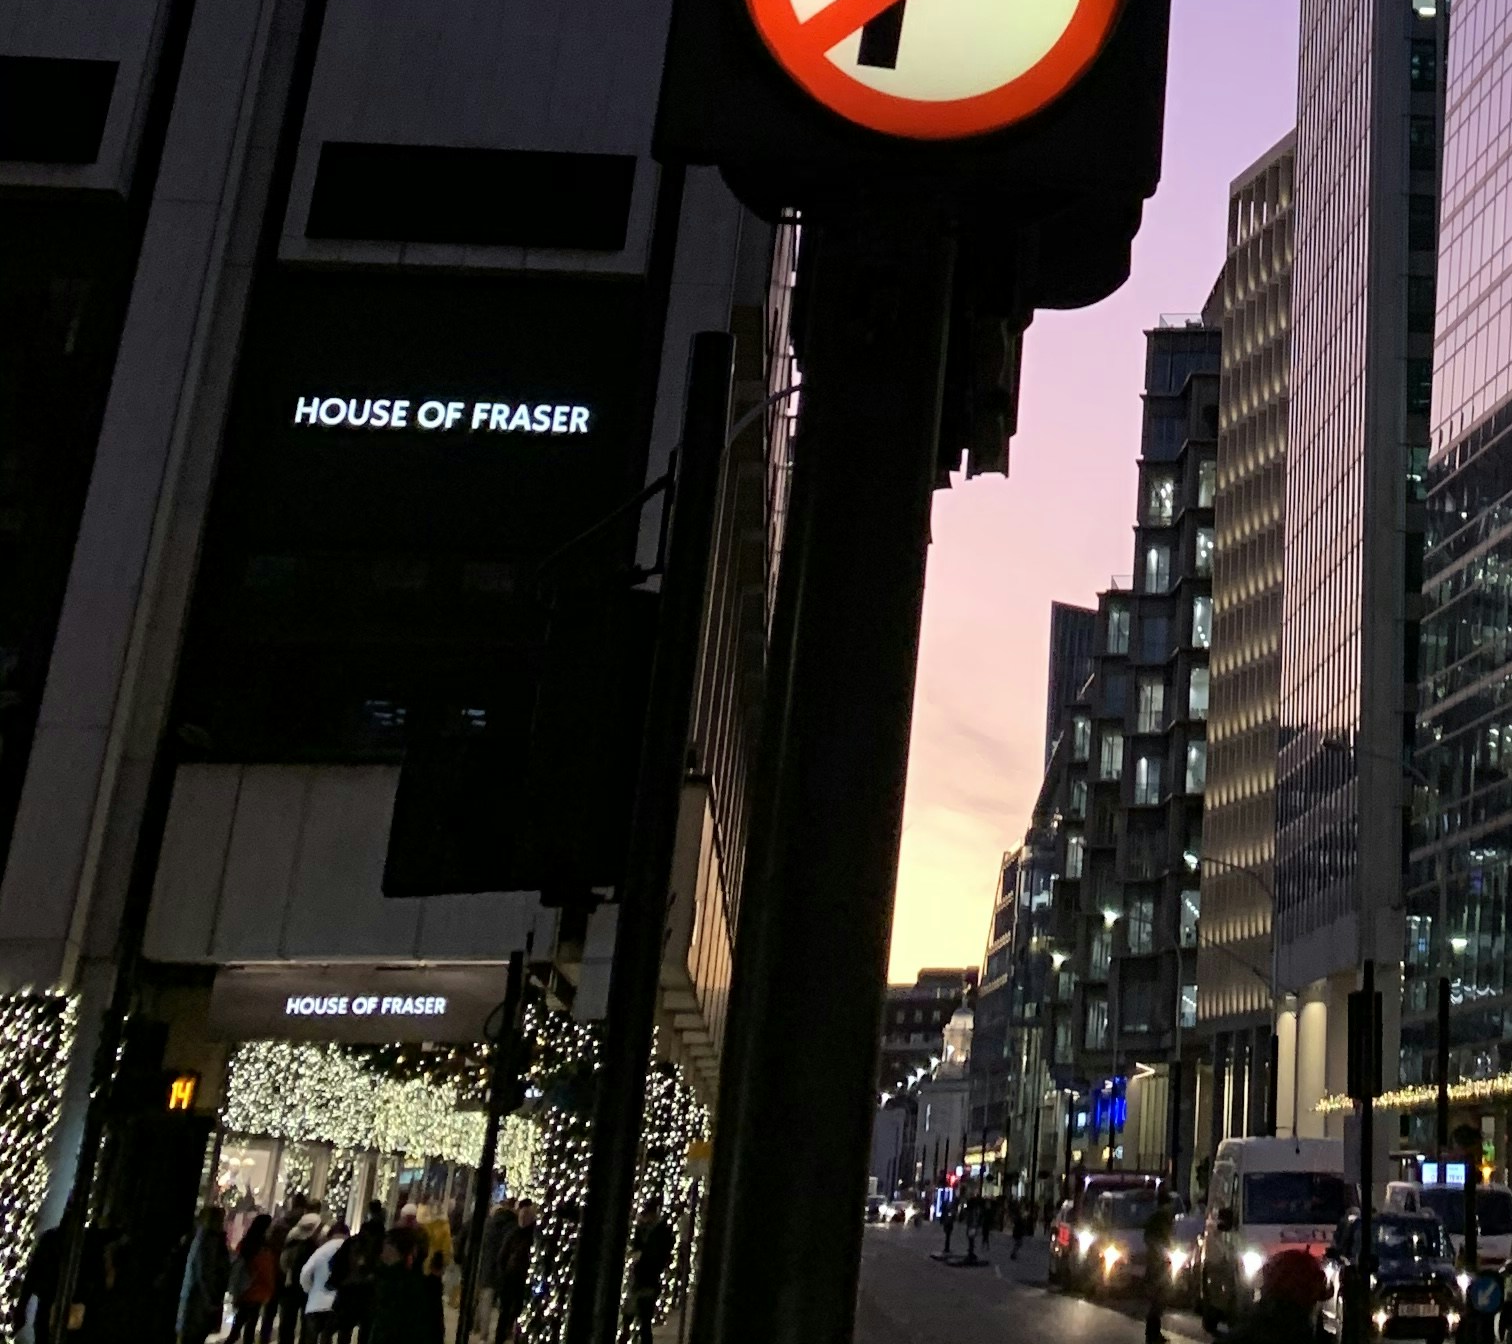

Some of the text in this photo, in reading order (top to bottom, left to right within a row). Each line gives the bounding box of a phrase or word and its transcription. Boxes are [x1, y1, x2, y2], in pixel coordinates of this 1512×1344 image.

[294, 396, 590, 433] HOUSE OF FRASER
[285, 997, 448, 1015] HOUSE OF FRASER
[168, 1077, 196, 1109] 14
